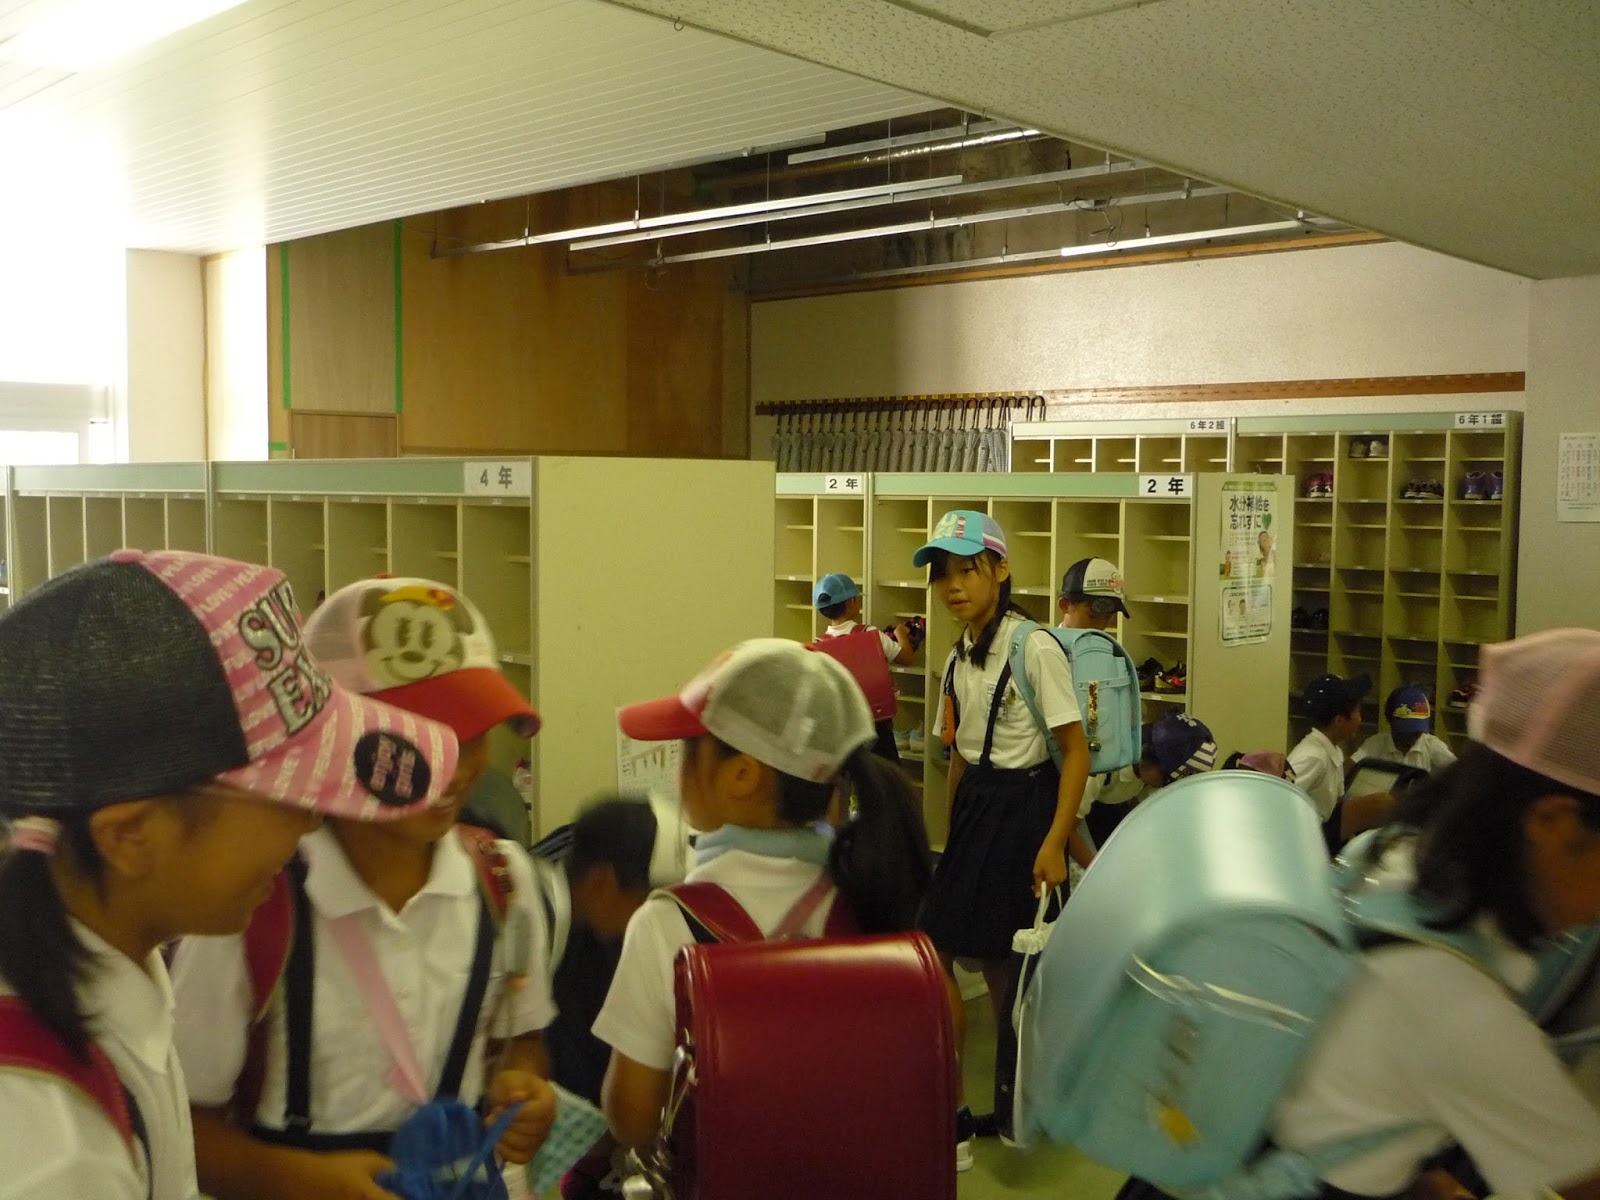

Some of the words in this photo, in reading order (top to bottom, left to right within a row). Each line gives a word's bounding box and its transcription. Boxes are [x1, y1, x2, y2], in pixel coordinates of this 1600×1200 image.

[1190, 420, 1225, 430] 6年2組
[1458, 414, 1502, 425] 6年1組
[480, 465, 512, 489] 4年
[829, 477, 858, 489] 2年
[1147, 477, 1184, 495] 2年
[1229, 494, 1270, 512] 水分補給を
